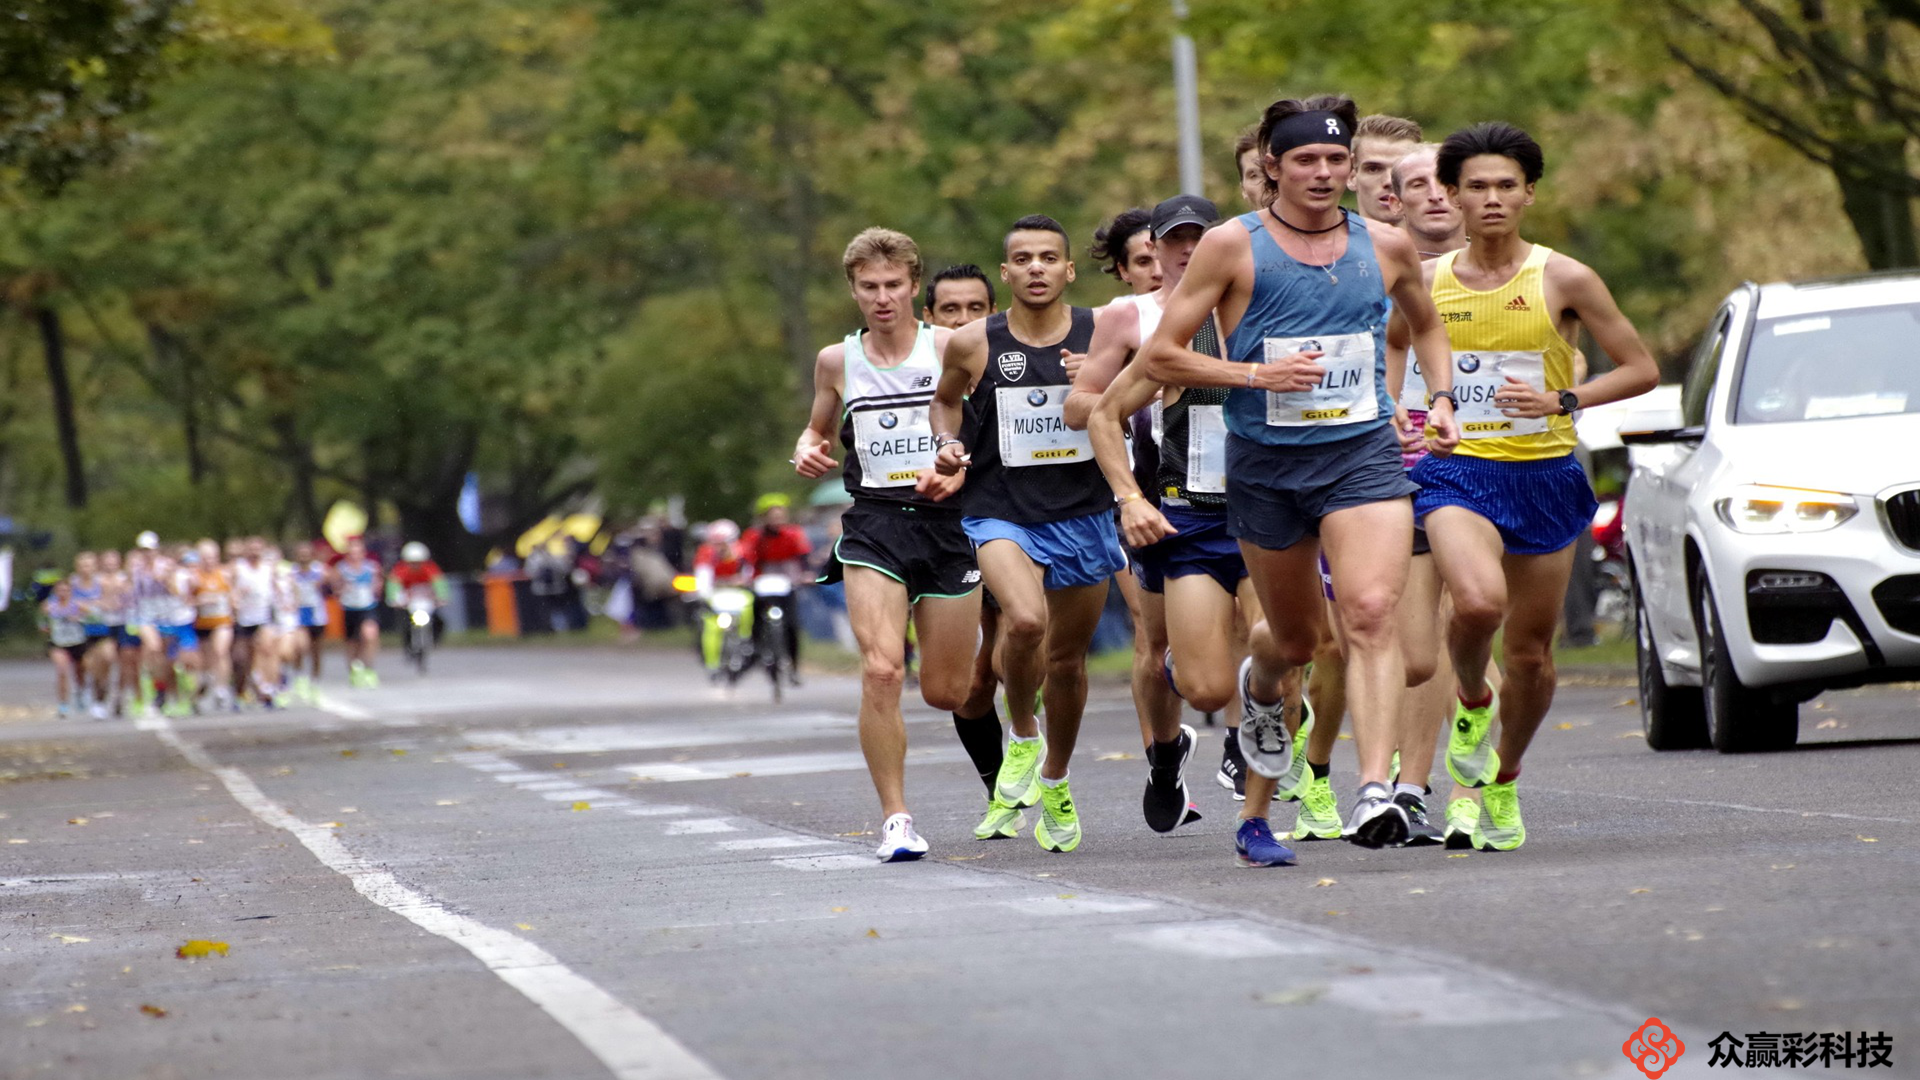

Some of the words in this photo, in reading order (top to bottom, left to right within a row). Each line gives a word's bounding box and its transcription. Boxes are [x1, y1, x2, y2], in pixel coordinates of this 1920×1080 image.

[1452, 384, 1500, 403] USA
[1305, 410, 1334, 419] Giti
[1465, 422, 1494, 431] Giti
[1034, 450, 1061, 459] Giti
[890, 471, 915, 480] Giti
